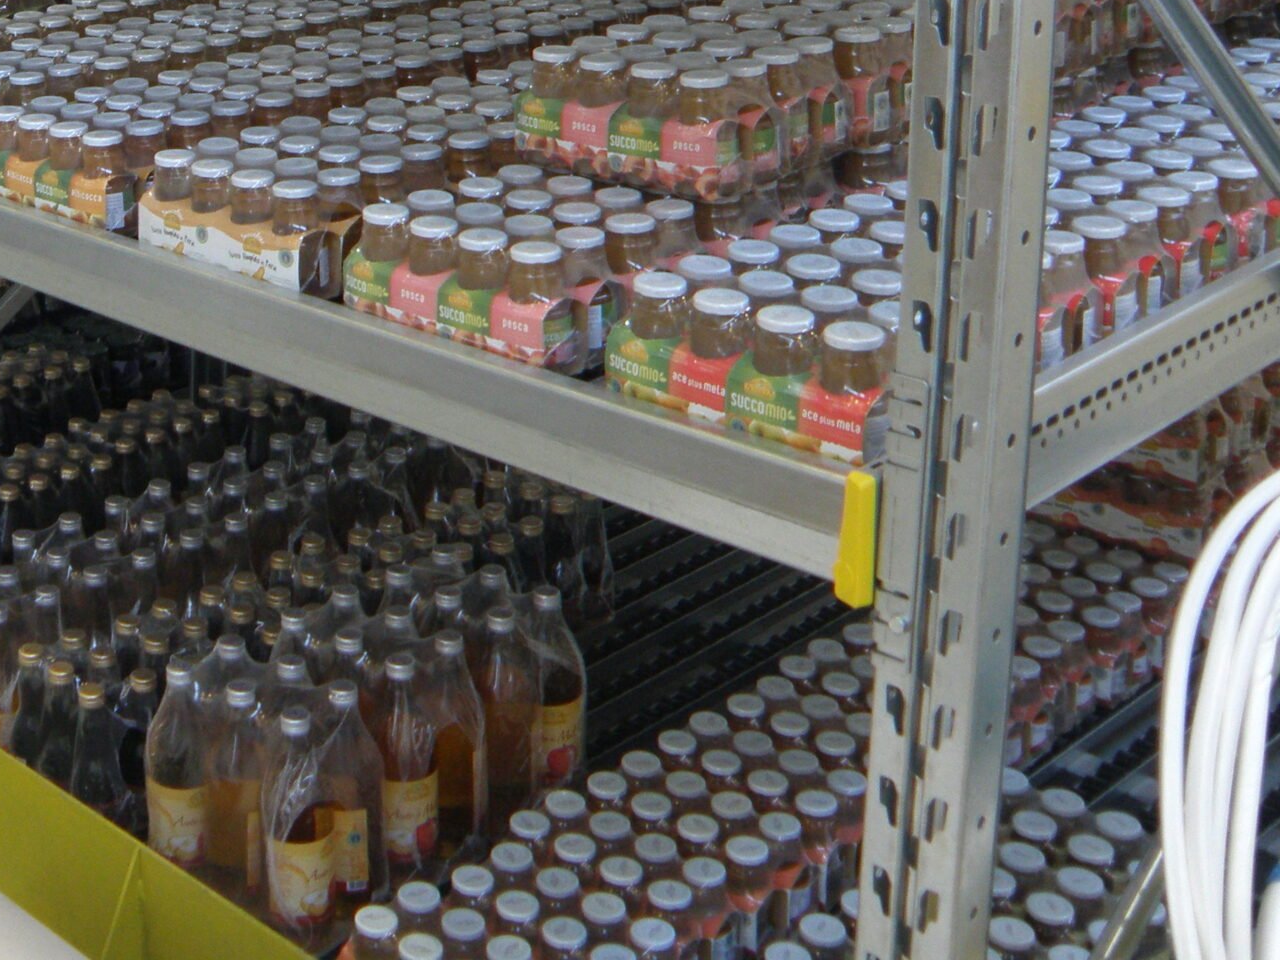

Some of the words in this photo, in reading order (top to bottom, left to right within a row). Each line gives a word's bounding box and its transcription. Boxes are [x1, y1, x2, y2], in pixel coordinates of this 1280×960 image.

[572, 120, 596, 133] pesca
[673, 141, 701, 153] pesca
[400, 288, 425, 304] pesca
[502, 318, 529, 333] pesca
[672, 371, 687, 385] ace
[703, 383, 726, 398] mela
[801, 408, 819, 422] ace
[836, 420, 862, 435] mela
